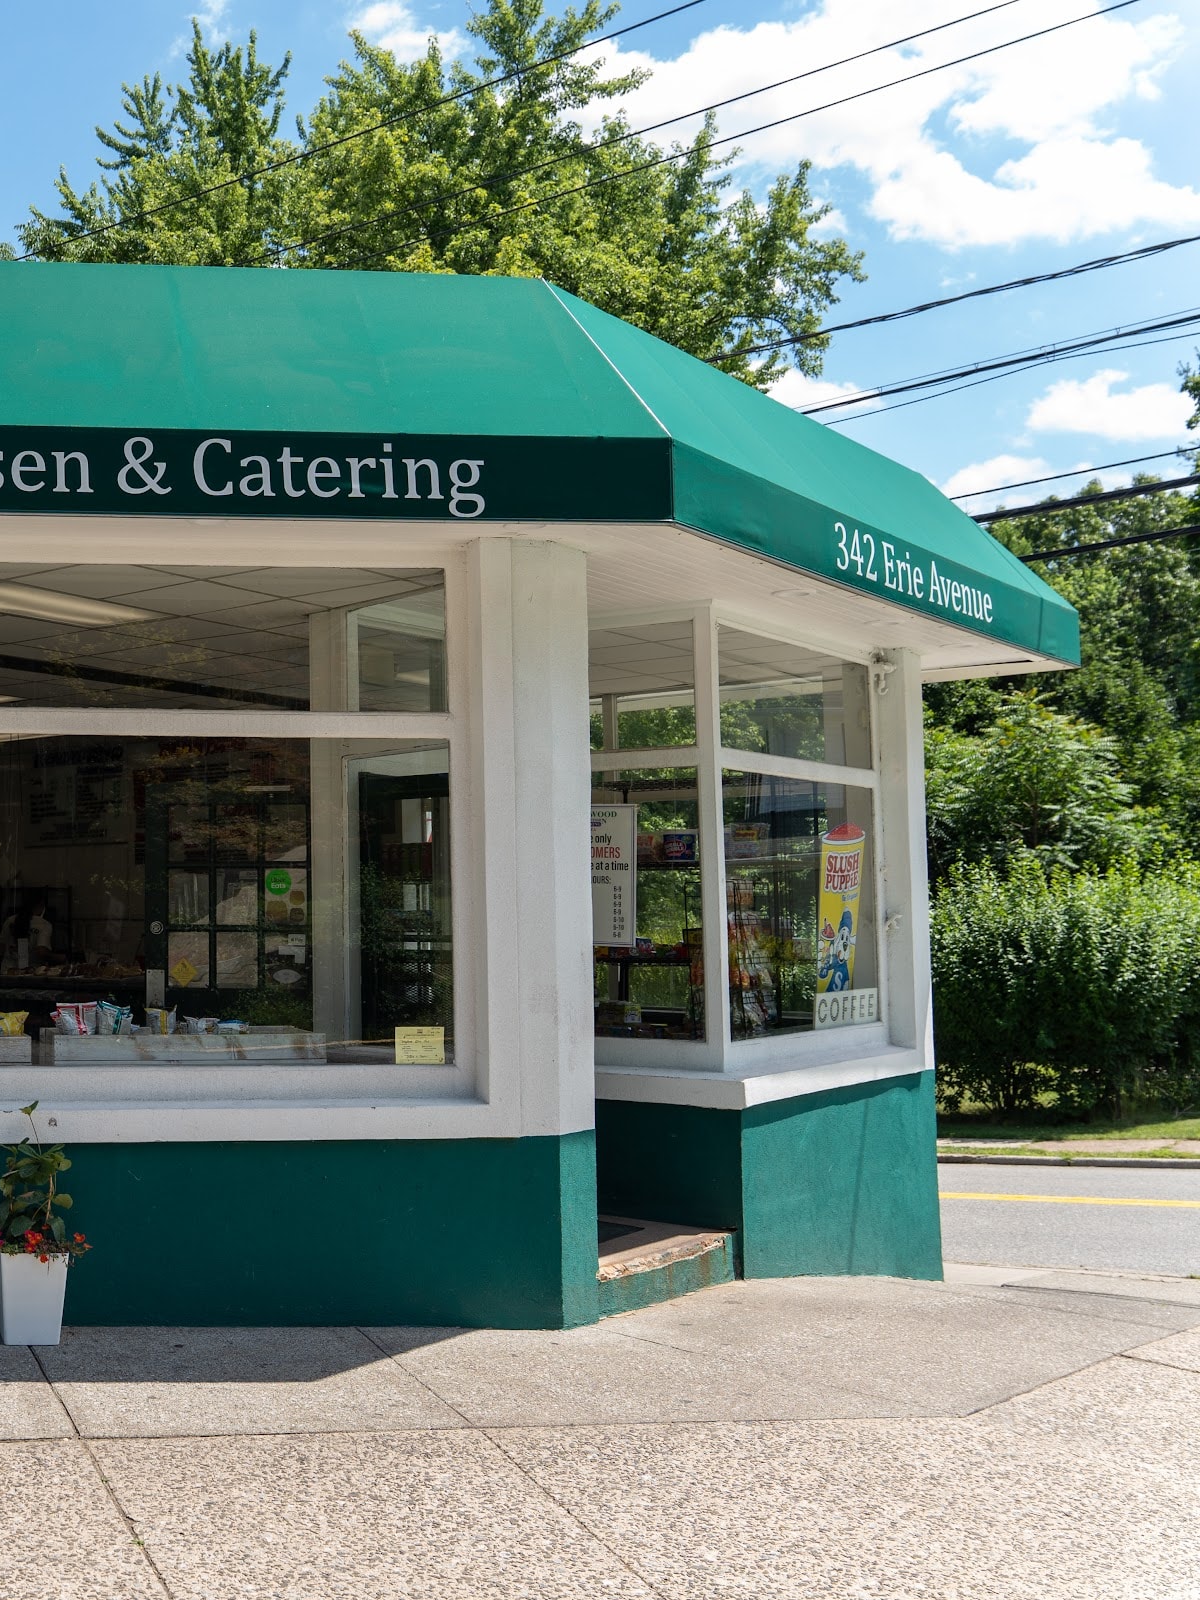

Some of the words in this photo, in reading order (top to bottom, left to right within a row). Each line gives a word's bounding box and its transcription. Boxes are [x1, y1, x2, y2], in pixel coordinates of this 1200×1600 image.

[117, 436, 173, 495] &
[193, 437, 486, 518] Catering
[834, 521, 878, 583] 342
[881, 540, 925, 599] Erie
[928, 560, 994, 624] Avenue
[595, 833, 612, 846] only
[595, 861, 603, 872] at
[604, 862, 610, 872] a
[611, 860, 629, 872] time
[826, 851, 860, 874] SLUSH
[592, 875, 612, 885] OURS:
[818, 993, 874, 1023] COFFEE
